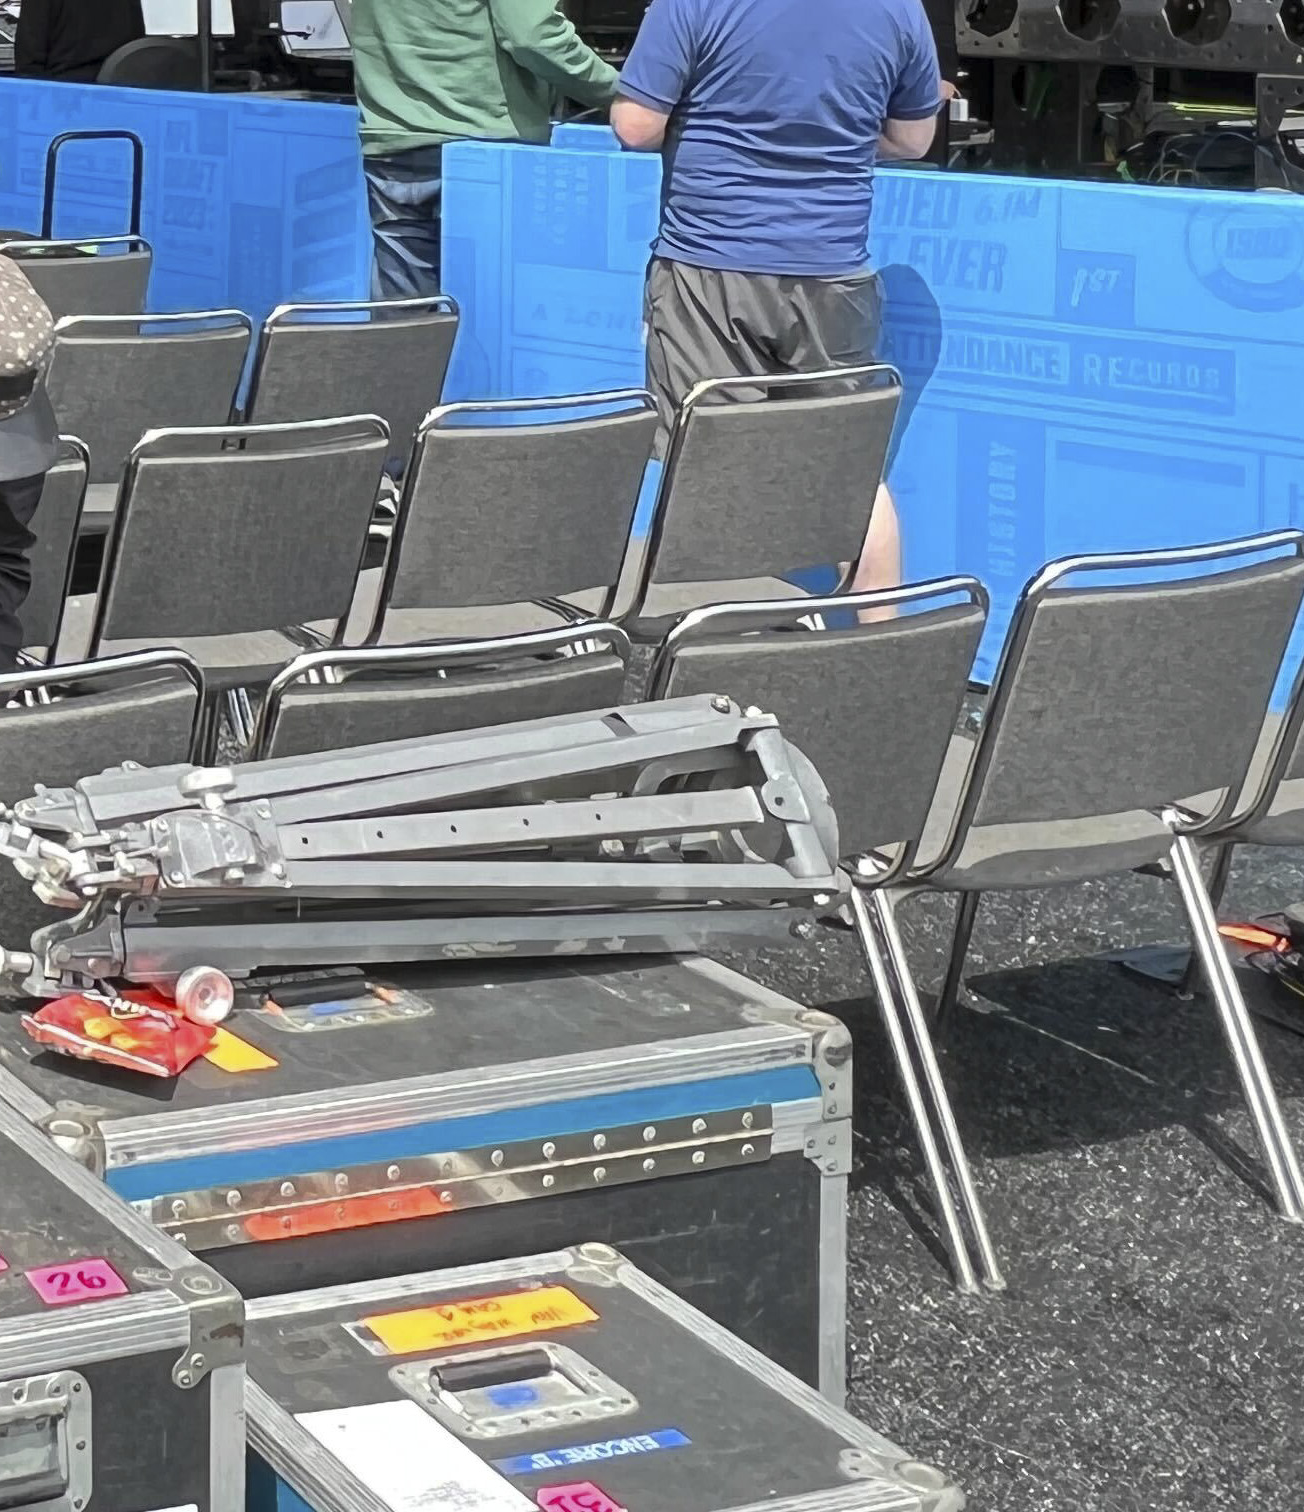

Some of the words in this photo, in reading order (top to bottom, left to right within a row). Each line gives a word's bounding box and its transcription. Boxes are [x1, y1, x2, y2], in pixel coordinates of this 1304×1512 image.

[987, 440, 1020, 578] HISTORY
[46, 1269, 108, 1298] 26
[561, 1433, 661, 1465] ENCORE
